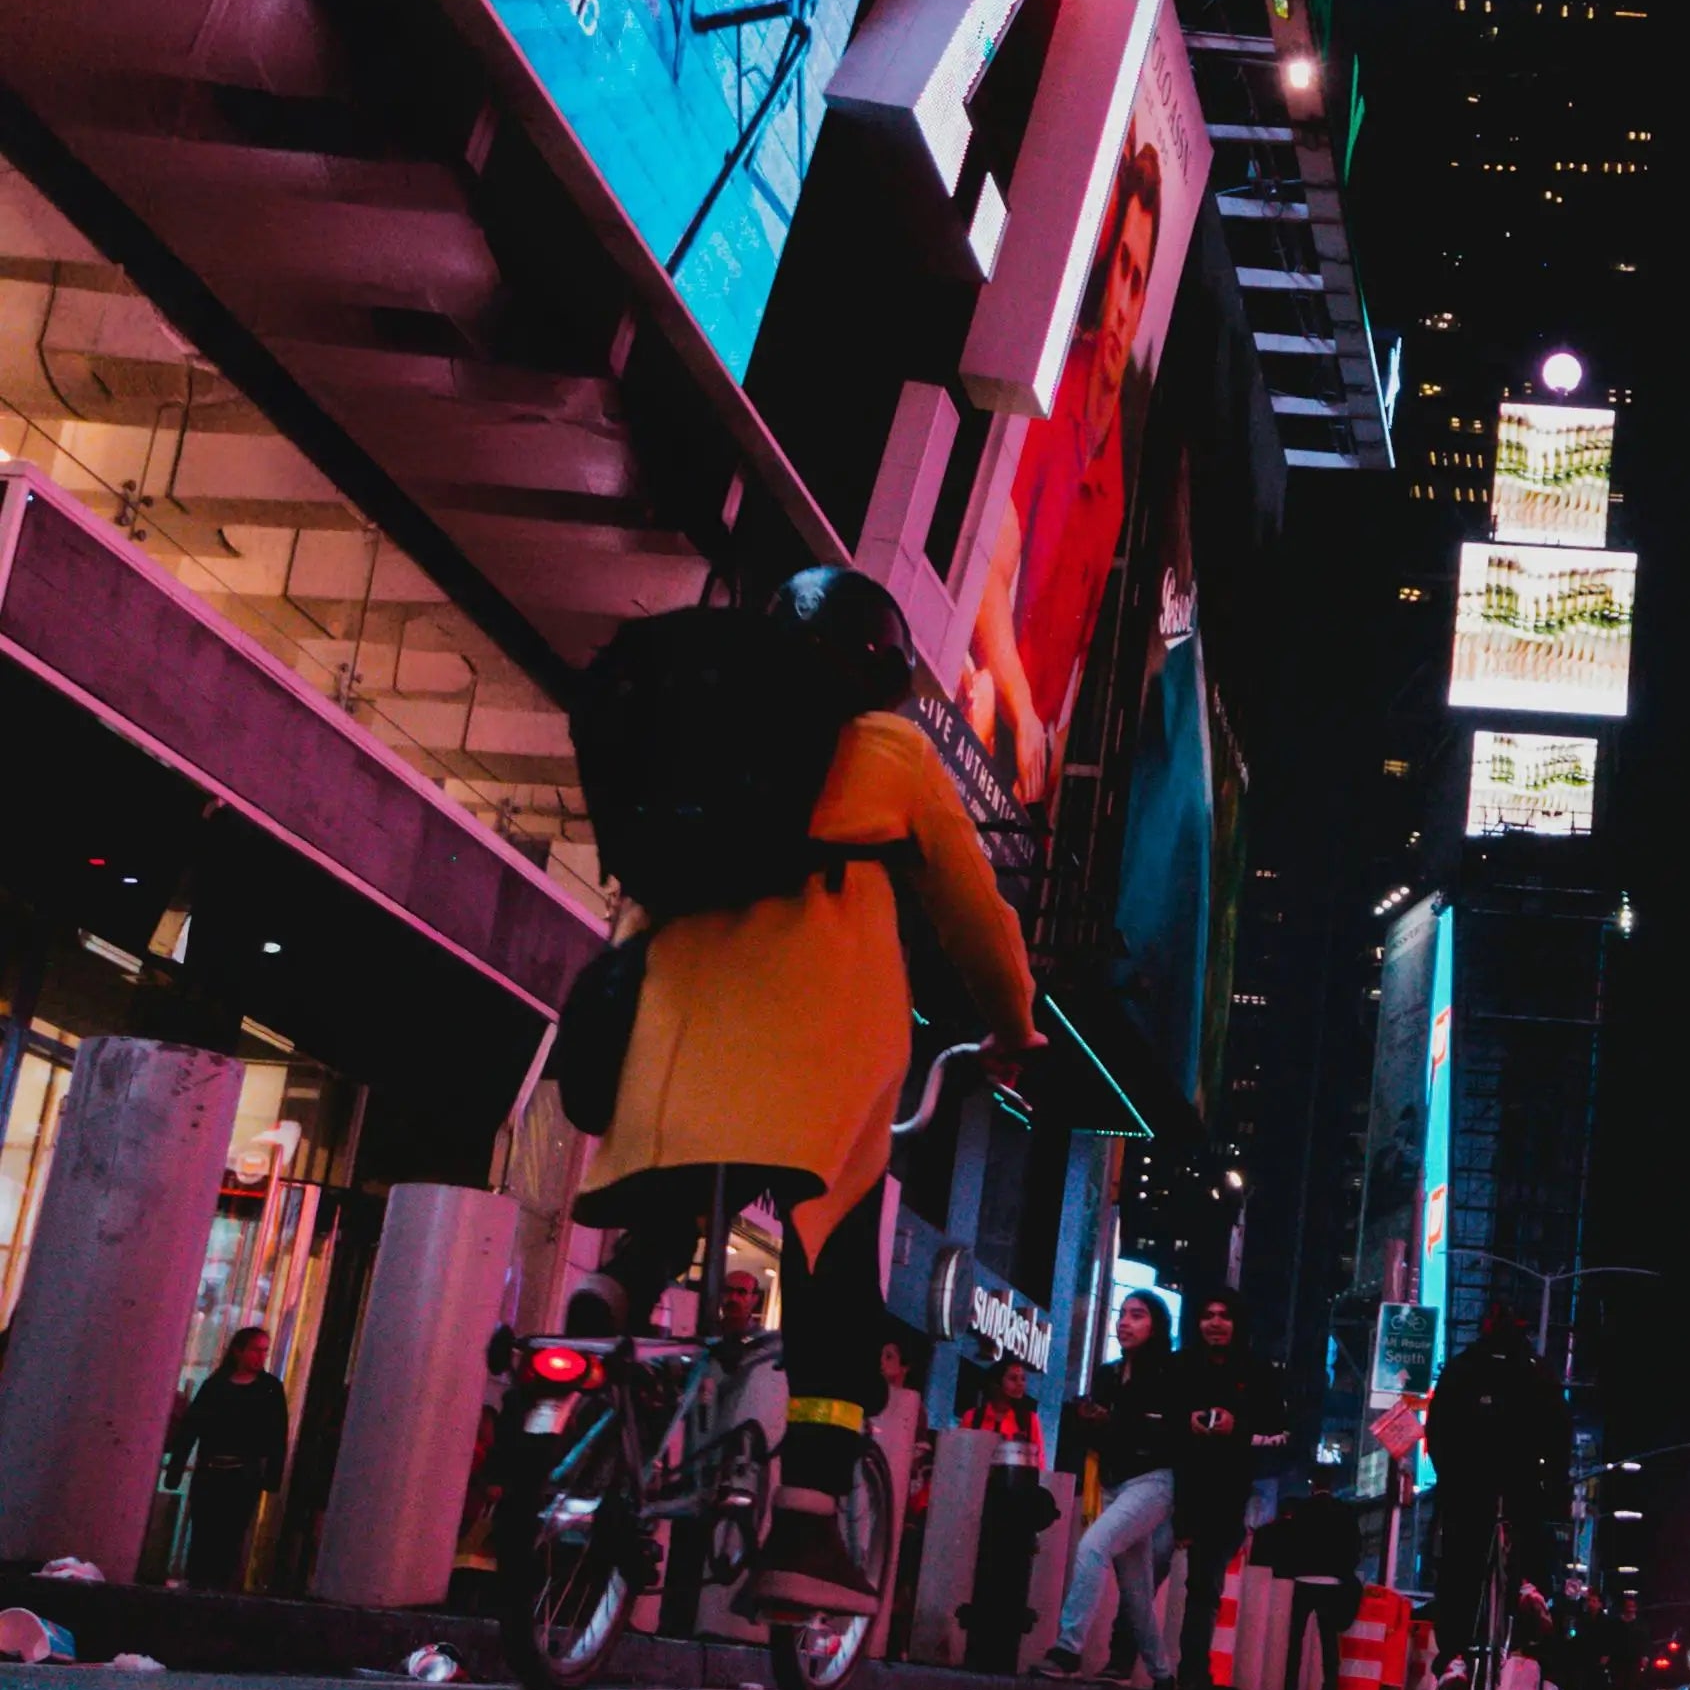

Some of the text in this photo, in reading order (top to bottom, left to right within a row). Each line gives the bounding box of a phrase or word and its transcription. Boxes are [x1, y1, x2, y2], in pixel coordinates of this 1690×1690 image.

[971, 1286, 1053, 1375] sunglass hut
[1385, 1350, 1427, 1365] South
